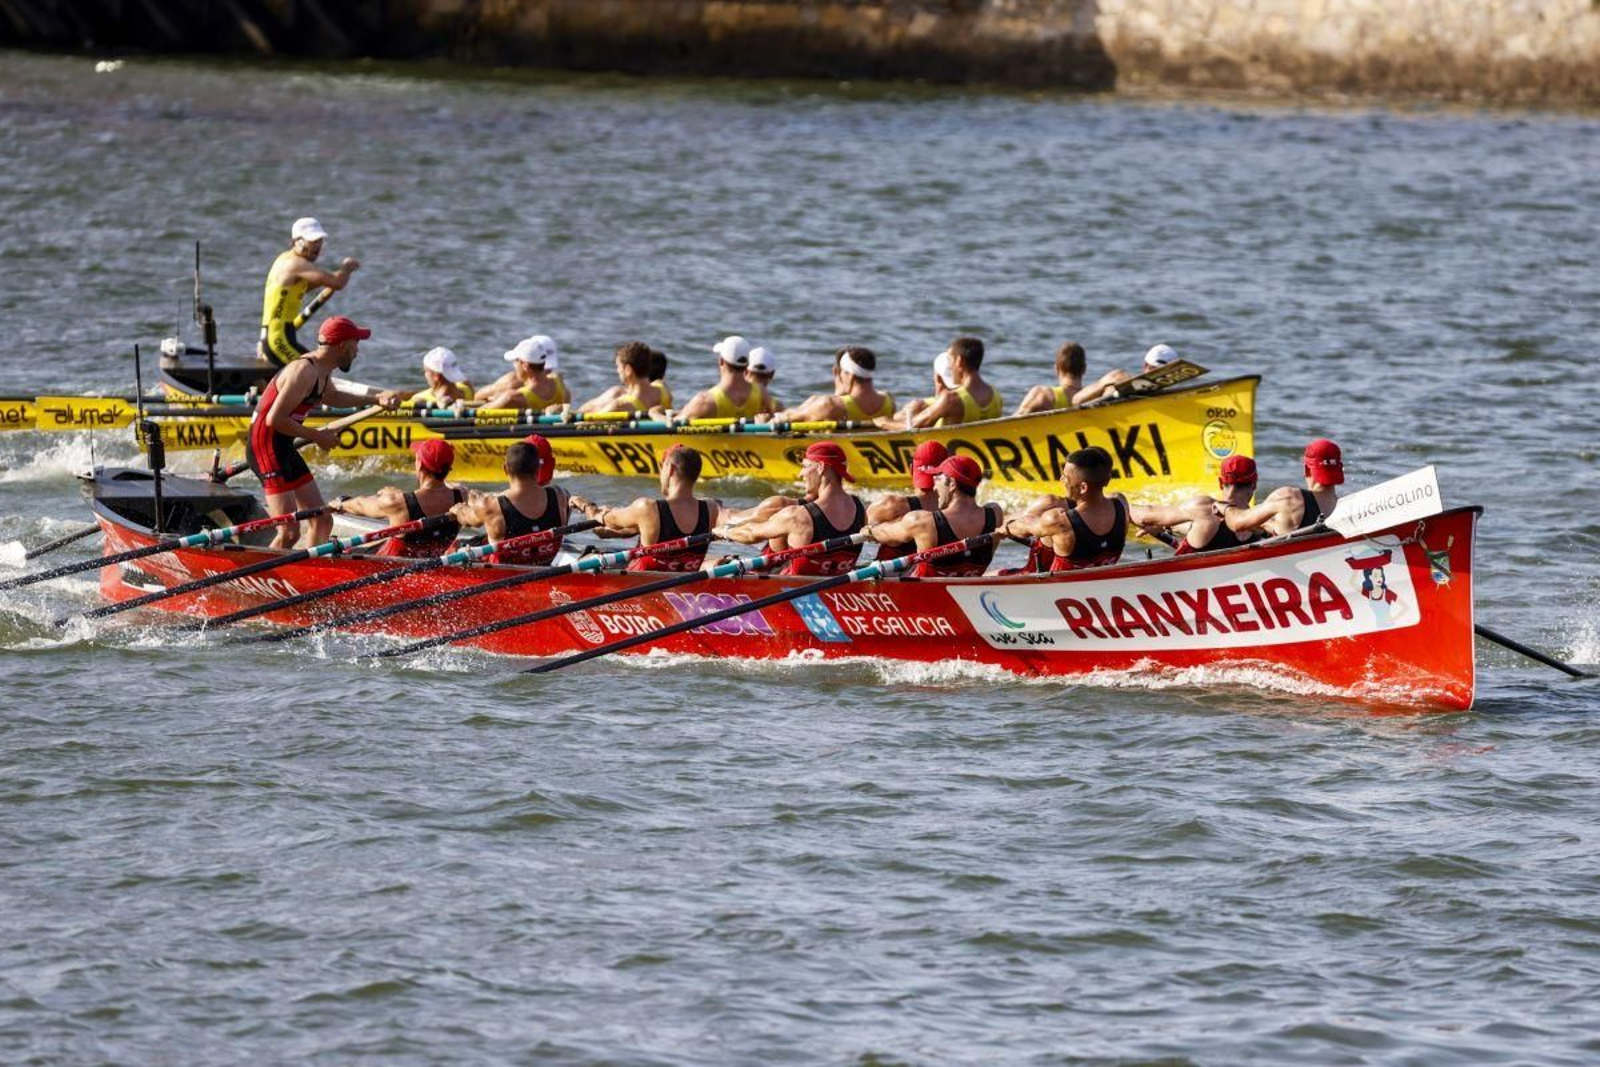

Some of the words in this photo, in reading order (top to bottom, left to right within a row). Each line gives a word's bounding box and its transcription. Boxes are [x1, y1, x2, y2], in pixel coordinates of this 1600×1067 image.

[1206, 408, 1237, 418] ORIO
[176, 424, 220, 446] KAXA
[712, 450, 765, 470] ORIO
[824, 593, 900, 612] XUNTA
[1055, 571, 1354, 640] RIANXEIRA
[598, 614, 667, 636] BOIRO
[842, 616, 875, 635] DE
[872, 616, 957, 636] GALICIA
